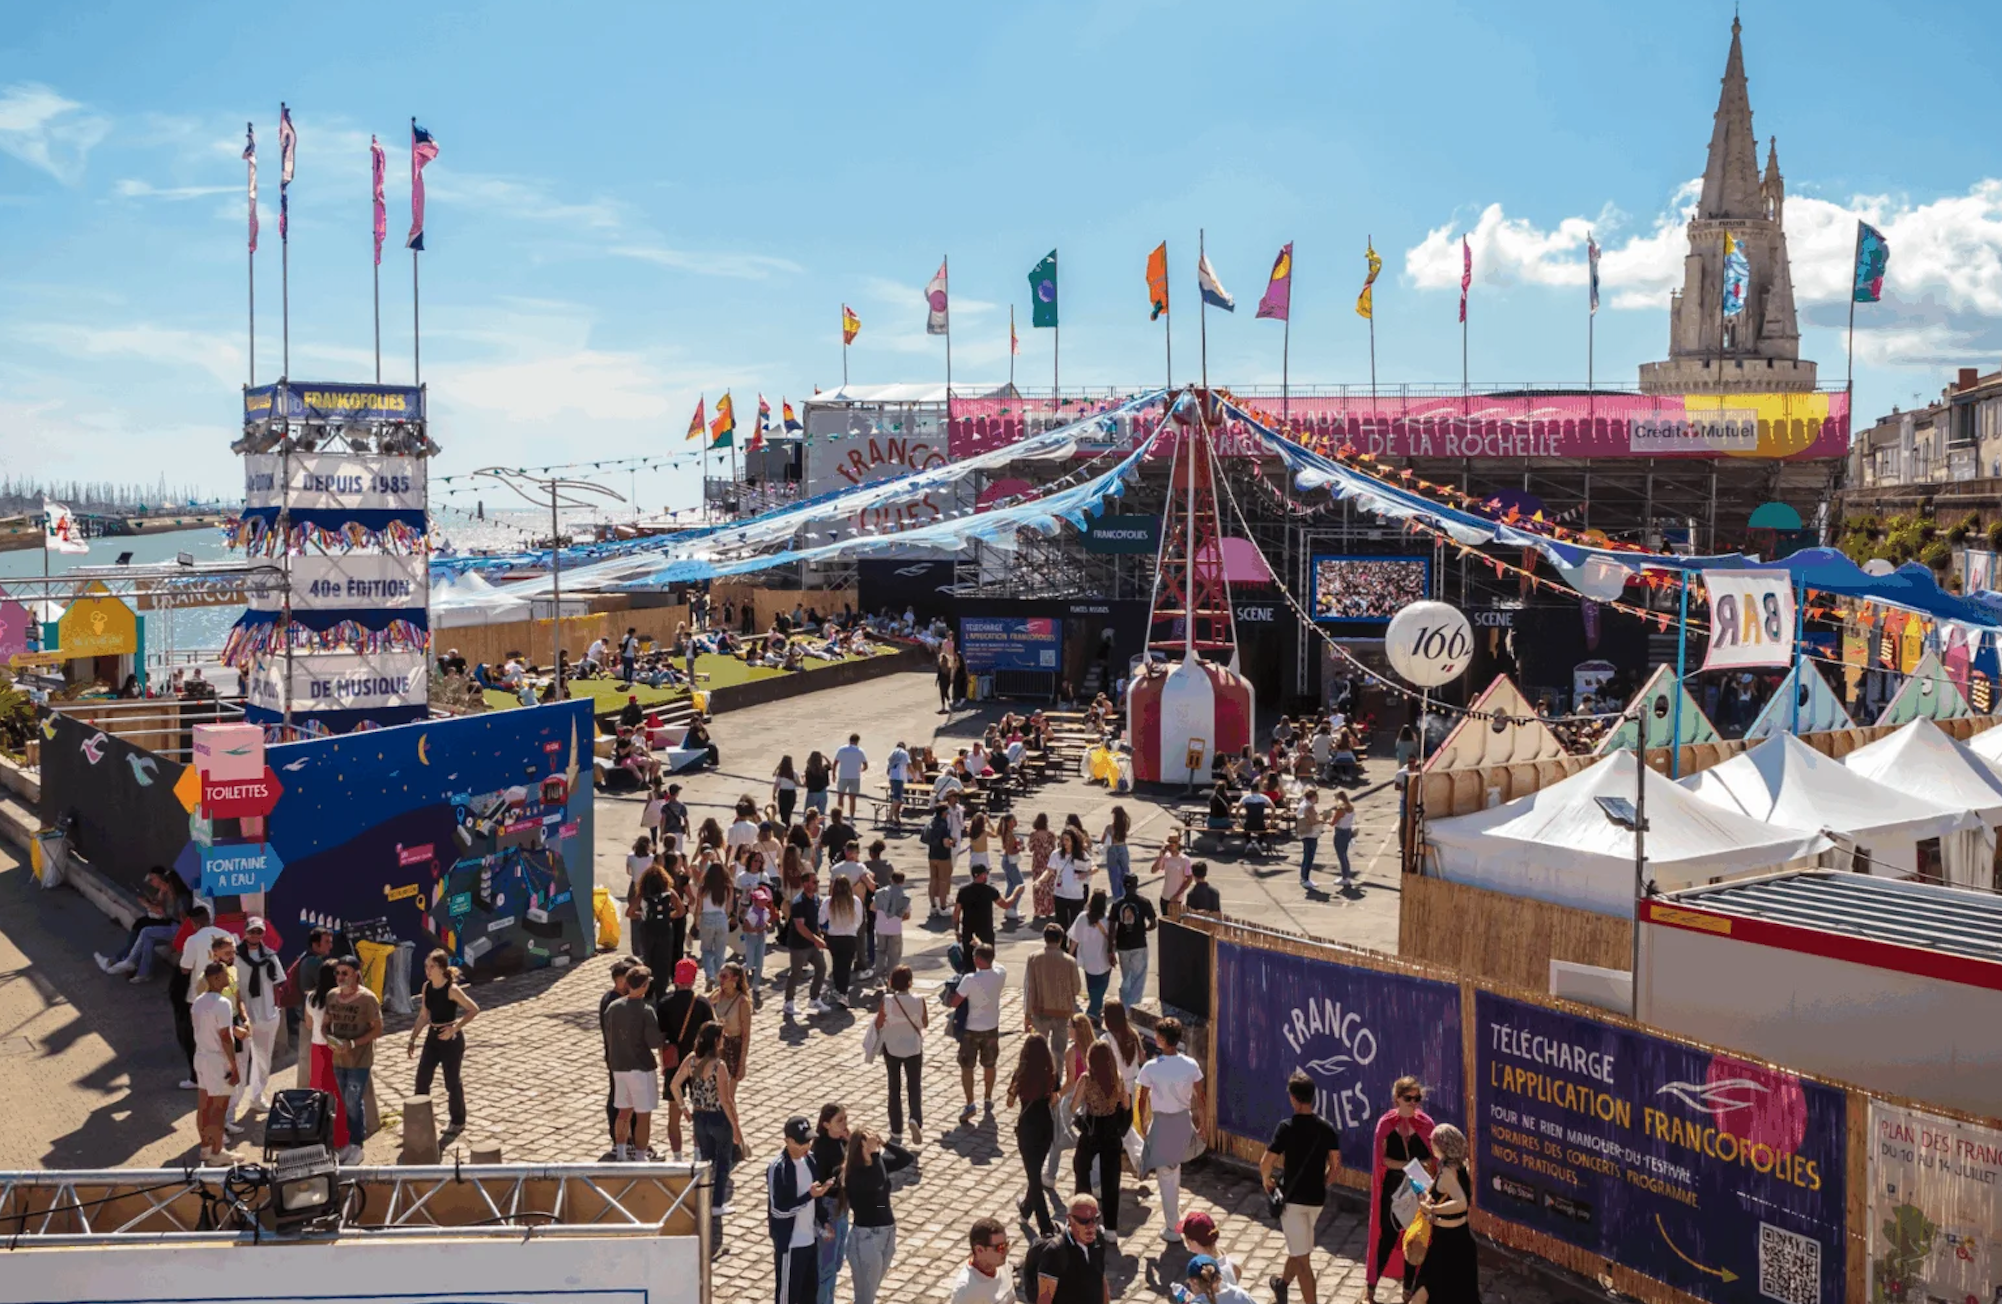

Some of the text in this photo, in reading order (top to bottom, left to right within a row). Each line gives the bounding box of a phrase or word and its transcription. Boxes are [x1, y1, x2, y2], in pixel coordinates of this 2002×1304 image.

[303, 391, 406, 411] FRANCOFOLIES
[1701, 424, 1755, 438] Mutuel
[1368, 434, 1397, 456] DE
[1410, 434, 1433, 456] LA
[1445, 434, 1561, 456] ROCHELLE
[303, 475, 410, 494] DEPUIS 1985
[1093, 530, 1148, 539] FRANCOFOLIES
[310, 577, 410, 598] 40e ÉDITION
[311, 676, 409, 698] DE MUSIQUE
[205, 784, 269, 801] TOILETTES
[206, 856, 267, 873] FONTAINE
[218, 873, 255, 887] A EAU
[1283, 997, 1377, 1065] FRANCO
[1491, 1023, 1614, 1084] TÉLÉCHARGE
[1490, 1104, 1518, 1125] POUR
[1522, 1114, 1535, 1131] NE
[1540, 1119, 1563, 1139] RIEN
[1567, 1129, 1622, 1158] MANQUER
[1625, 1148, 1641, 1165] DU
[1491, 1060, 1822, 1190] L'APPLICATION FRANCOFOLIES
[1491, 1123, 1540, 1151] HORAIRES
[1545, 1141, 1562, 1159] DES
[1882, 1120, 2002, 1166] PLAN DES FRAN
[1491, 1143, 1518, 1164] INFOS
[1881, 1142, 1998, 1185] DU 10 AU 14 JUILLET
